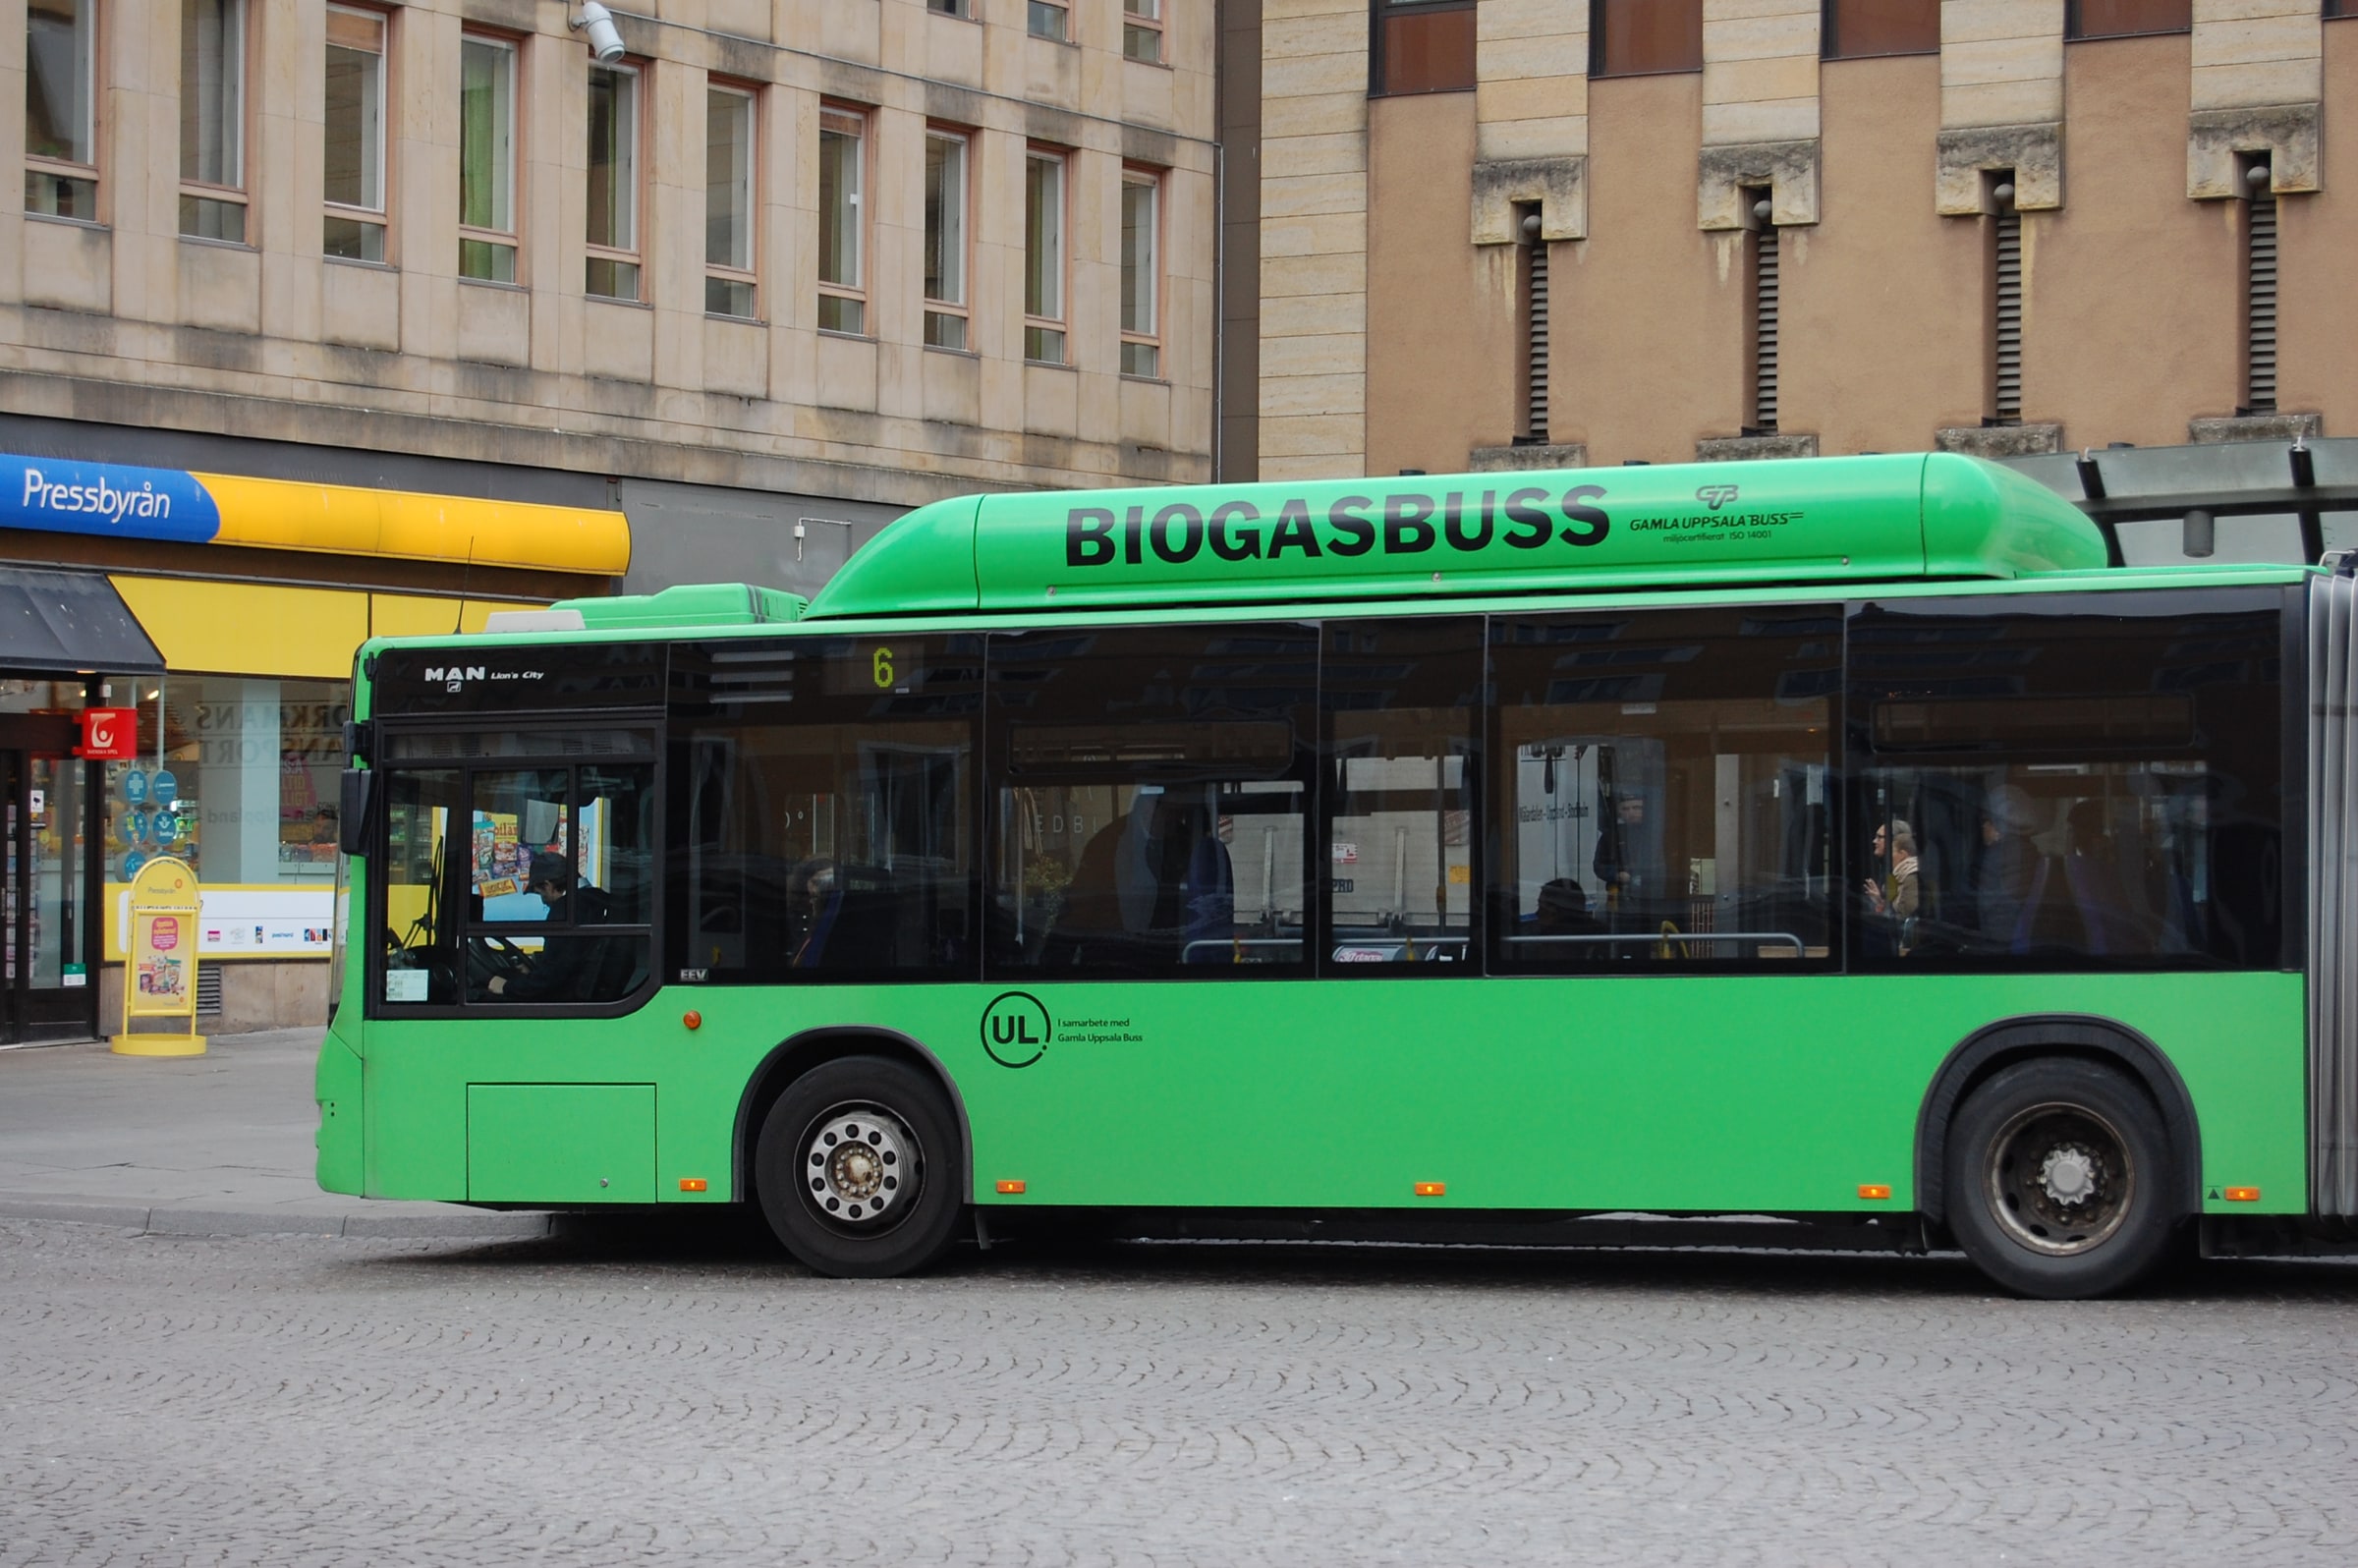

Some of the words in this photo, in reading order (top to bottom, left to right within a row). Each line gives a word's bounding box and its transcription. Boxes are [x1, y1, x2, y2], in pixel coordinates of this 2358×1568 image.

[23, 469, 170, 524] Pressbyrån
[1066, 484, 1610, 567] BIOGASBUSS
[1630, 518, 1679, 532] GAMLA
[1682, 515, 1746, 529] UPPSALA
[1747, 513, 1789, 527] BUSS
[1729, 531, 1745, 540] ISO
[1747, 530, 1771, 539] 14001
[424, 666, 485, 682] MAN
[490, 671, 519, 680] Lion's
[522, 671, 544, 680] City
[872, 645, 895, 689] 6
[680, 969, 708, 981] EEV
[992, 1015, 1039, 1044] UL
[1061, 1018, 1108, 1028] samarbete
[1109, 1018, 1130, 1028] med
[1057, 1033, 1086, 1042] Gamla
[1088, 1033, 1122, 1044] Uppsala
[1123, 1033, 1143, 1042] Buss
